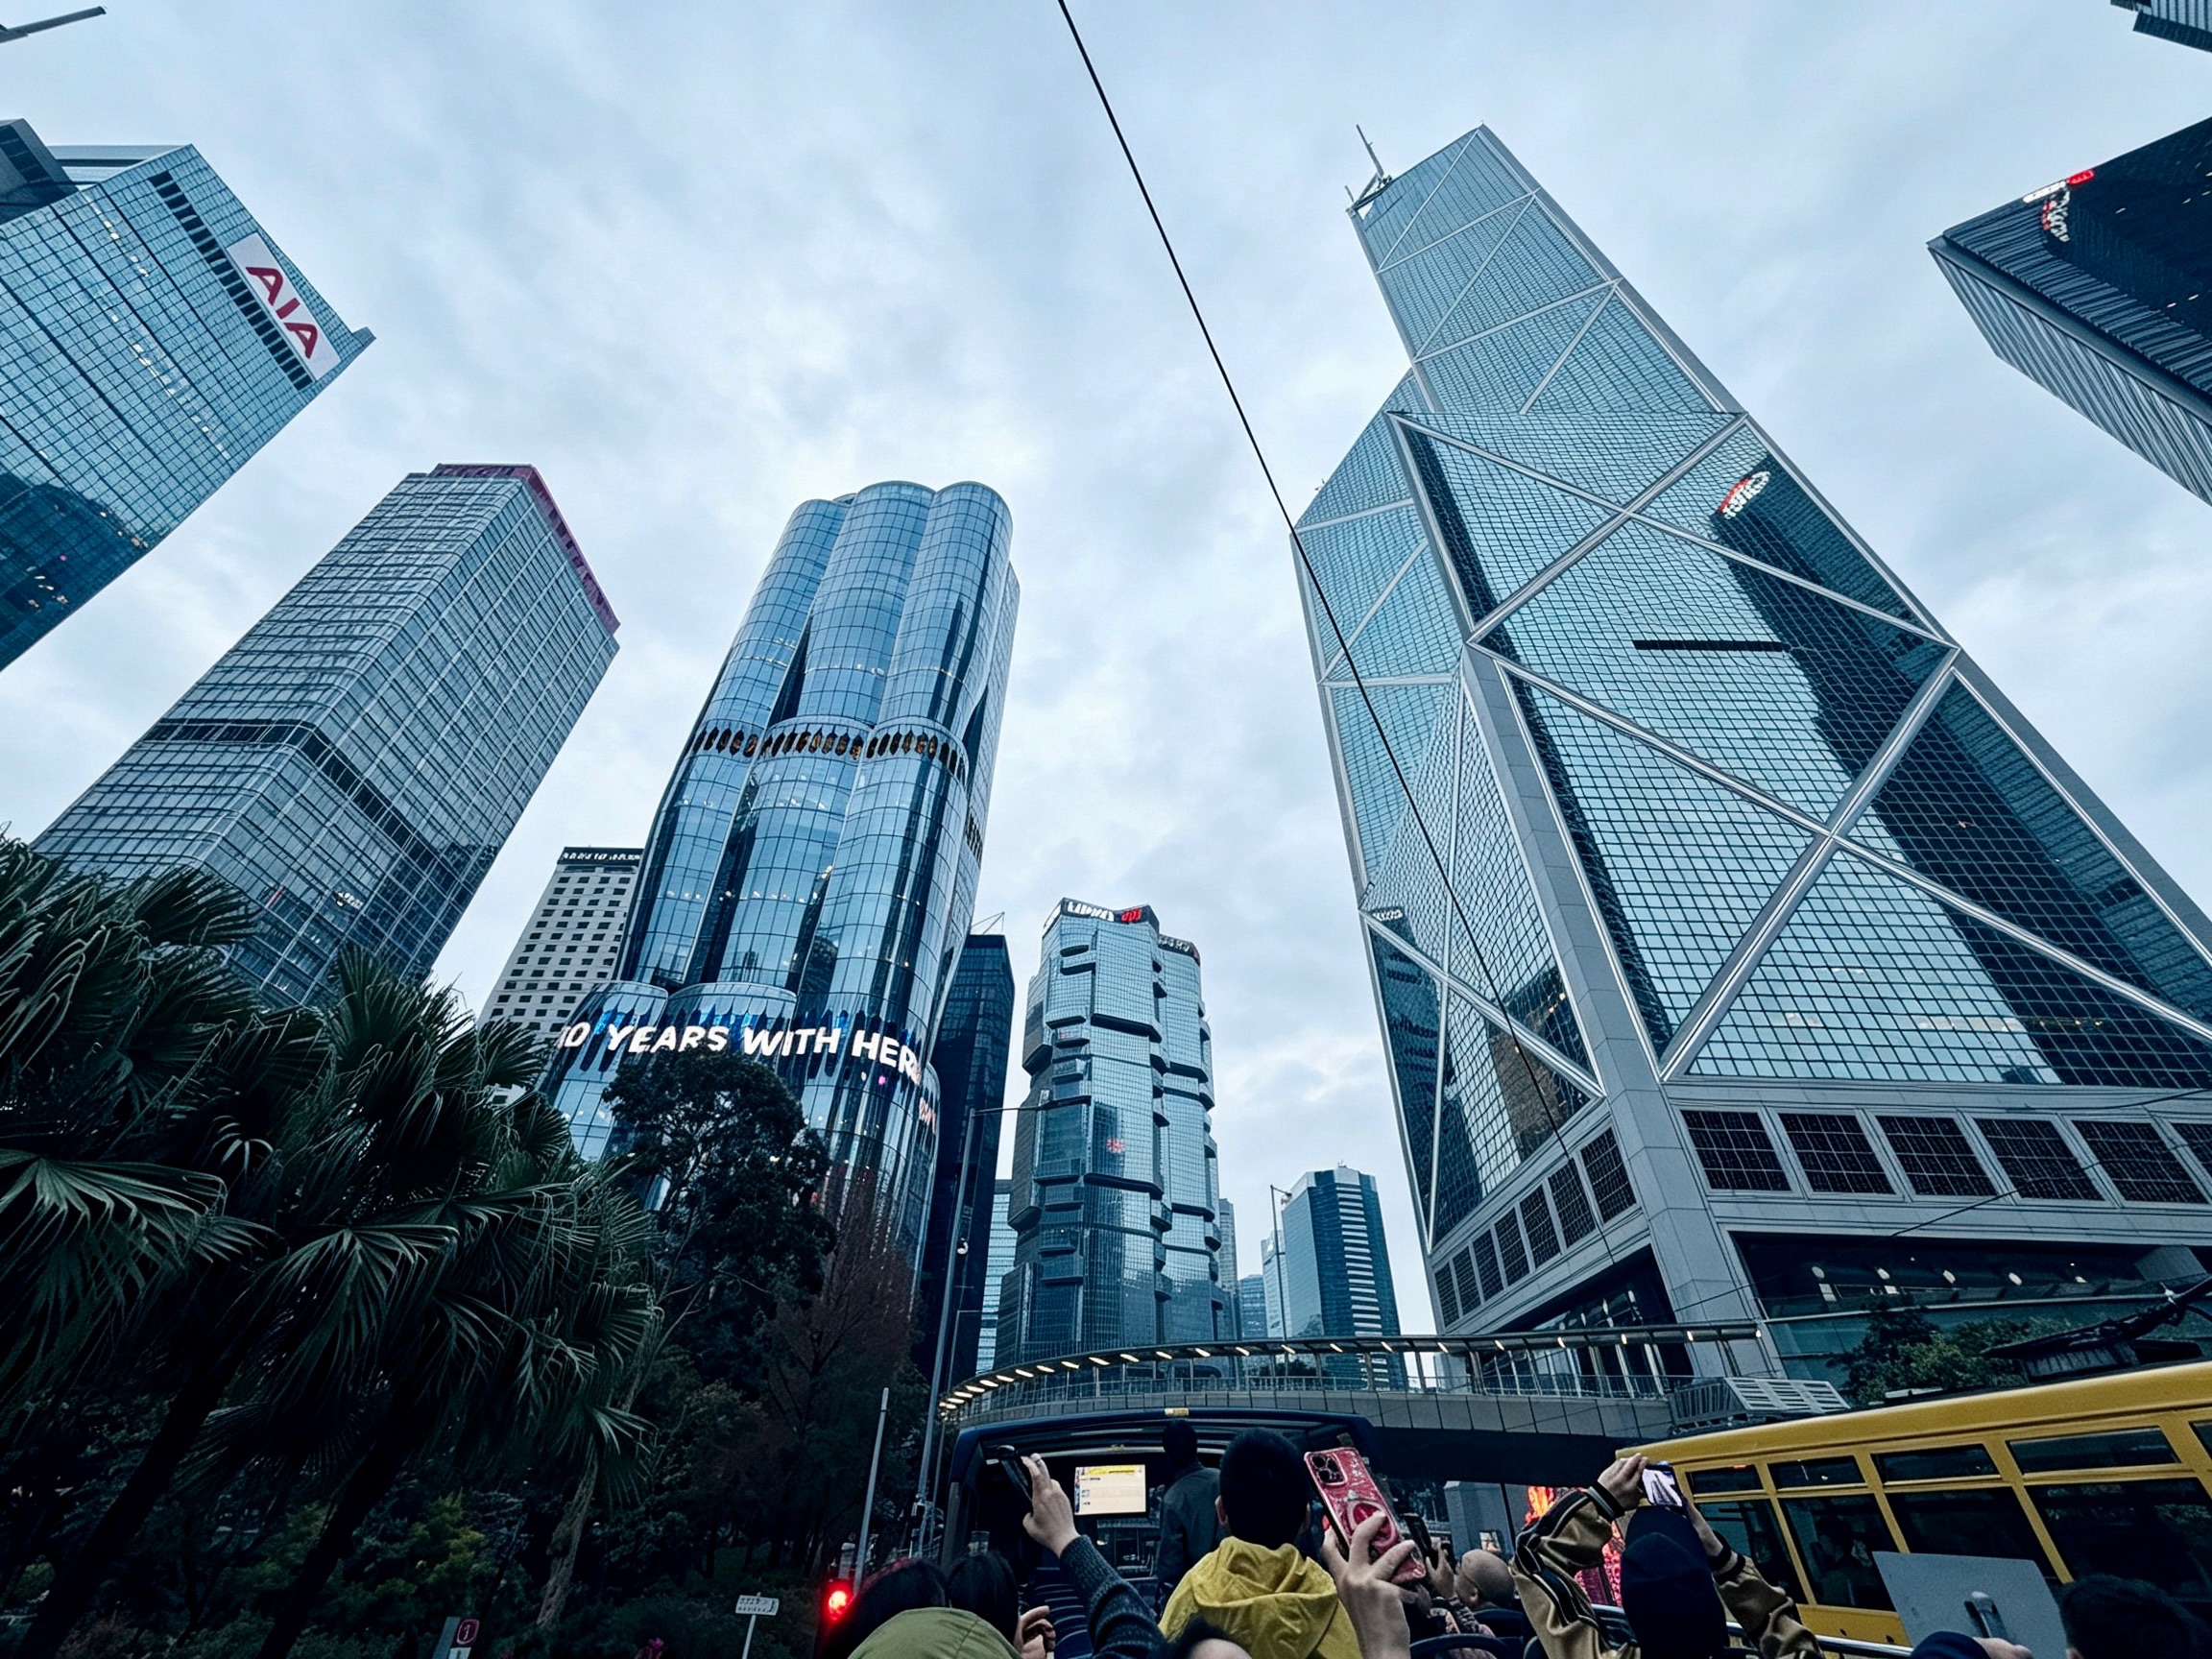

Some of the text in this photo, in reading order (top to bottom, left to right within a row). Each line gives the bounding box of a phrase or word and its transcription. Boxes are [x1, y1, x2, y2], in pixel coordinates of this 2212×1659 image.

[245, 267, 318, 359] AIA
[607, 1023, 731, 1053] YEARS
[743, 1026, 841, 1056] WITH
